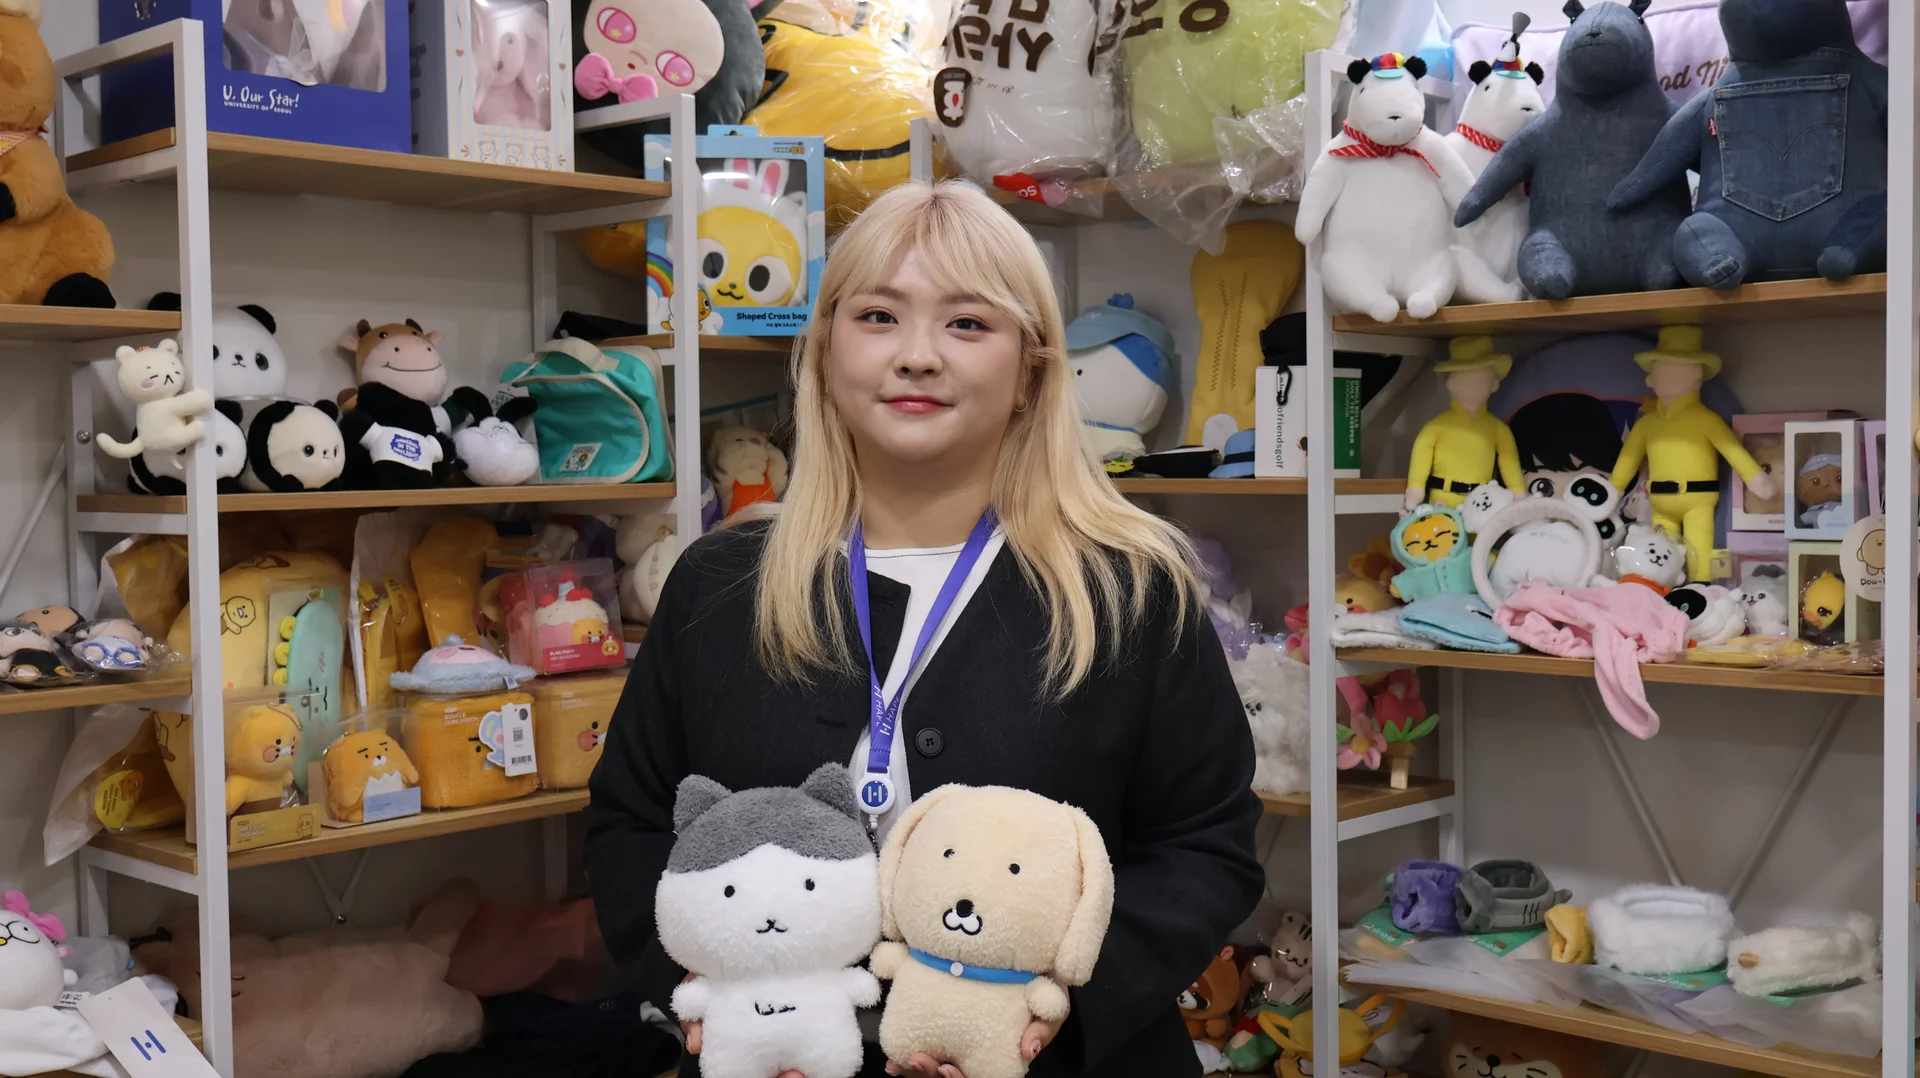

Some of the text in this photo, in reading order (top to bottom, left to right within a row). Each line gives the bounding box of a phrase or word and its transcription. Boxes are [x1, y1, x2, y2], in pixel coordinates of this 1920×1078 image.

[240, 86, 264, 102] Our
[268, 88, 300, 110] Star!
[223, 101, 260, 111] UNIVERSITY
[273, 106, 293, 115] SEOUL
[736, 312, 808, 322] Shaped Cross bag
